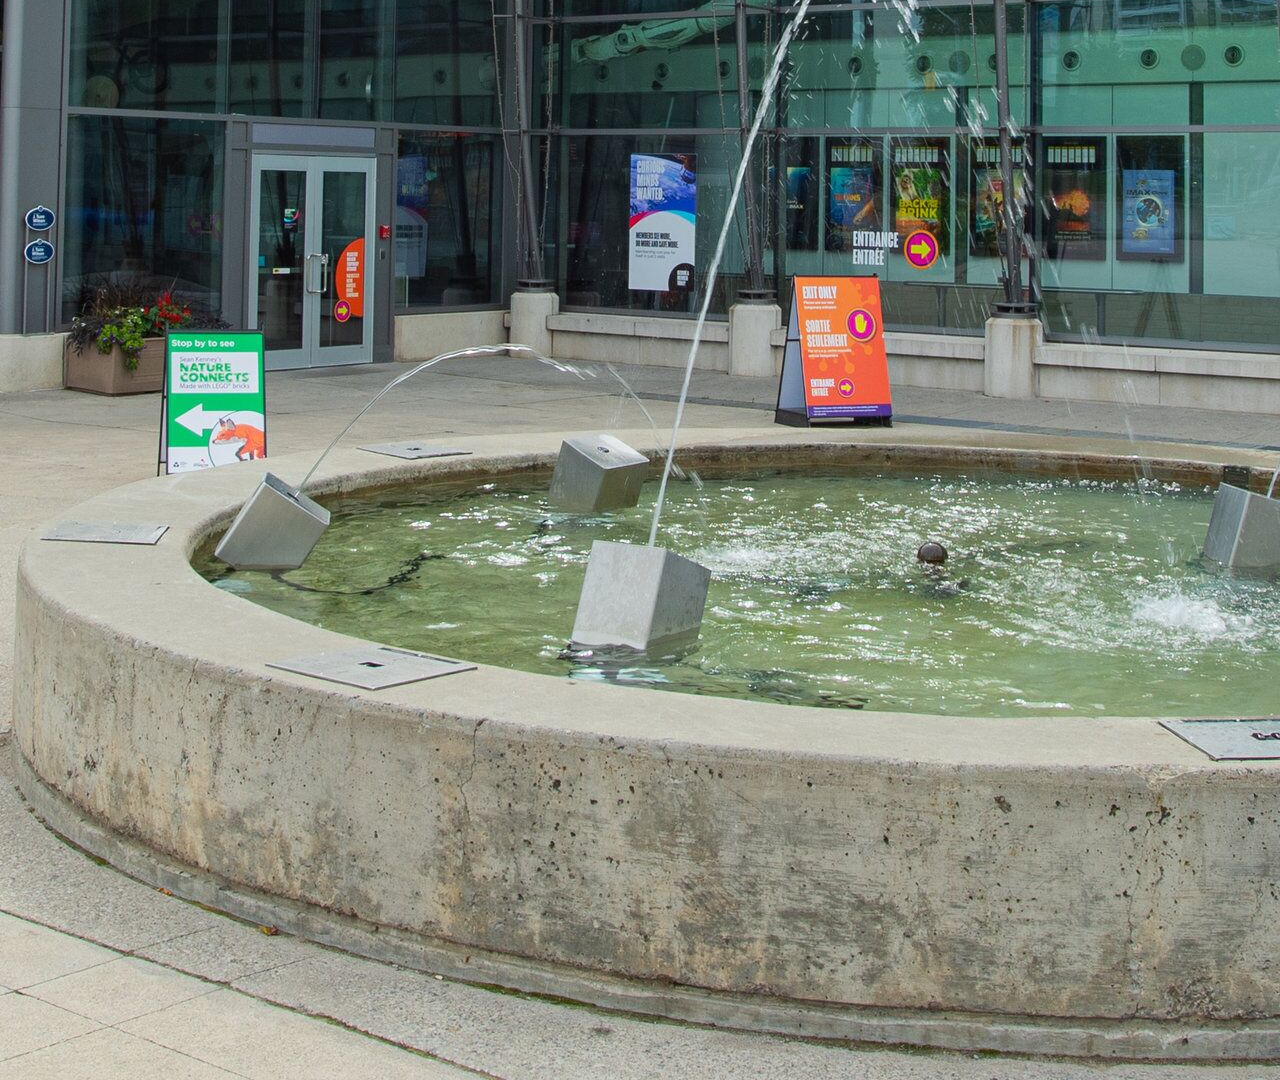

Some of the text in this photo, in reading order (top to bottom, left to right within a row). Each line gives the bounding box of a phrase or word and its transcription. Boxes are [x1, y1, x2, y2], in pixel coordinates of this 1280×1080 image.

[637, 160, 665, 173] CURIOUS
[637, 174, 660, 186] MINDS
[636, 187, 665, 201] WANTED.
[899, 199, 926, 208] BACK
[899, 208, 937, 218] BRINK
[853, 231, 899, 248] ENTRANCE
[853, 248, 884, 265] ENTRÉE
[802, 286, 837, 299] EXIT ONLY
[805, 320, 831, 332] SORTIE
[171, 339, 192, 348] Stop
[194, 339, 206, 348] by
[807, 334, 848, 347] SEULEMENT
[180, 363, 231, 372] NATURE
[180, 373, 249, 382] CONNECTS
[811, 379, 835, 387] ENTRANCE
